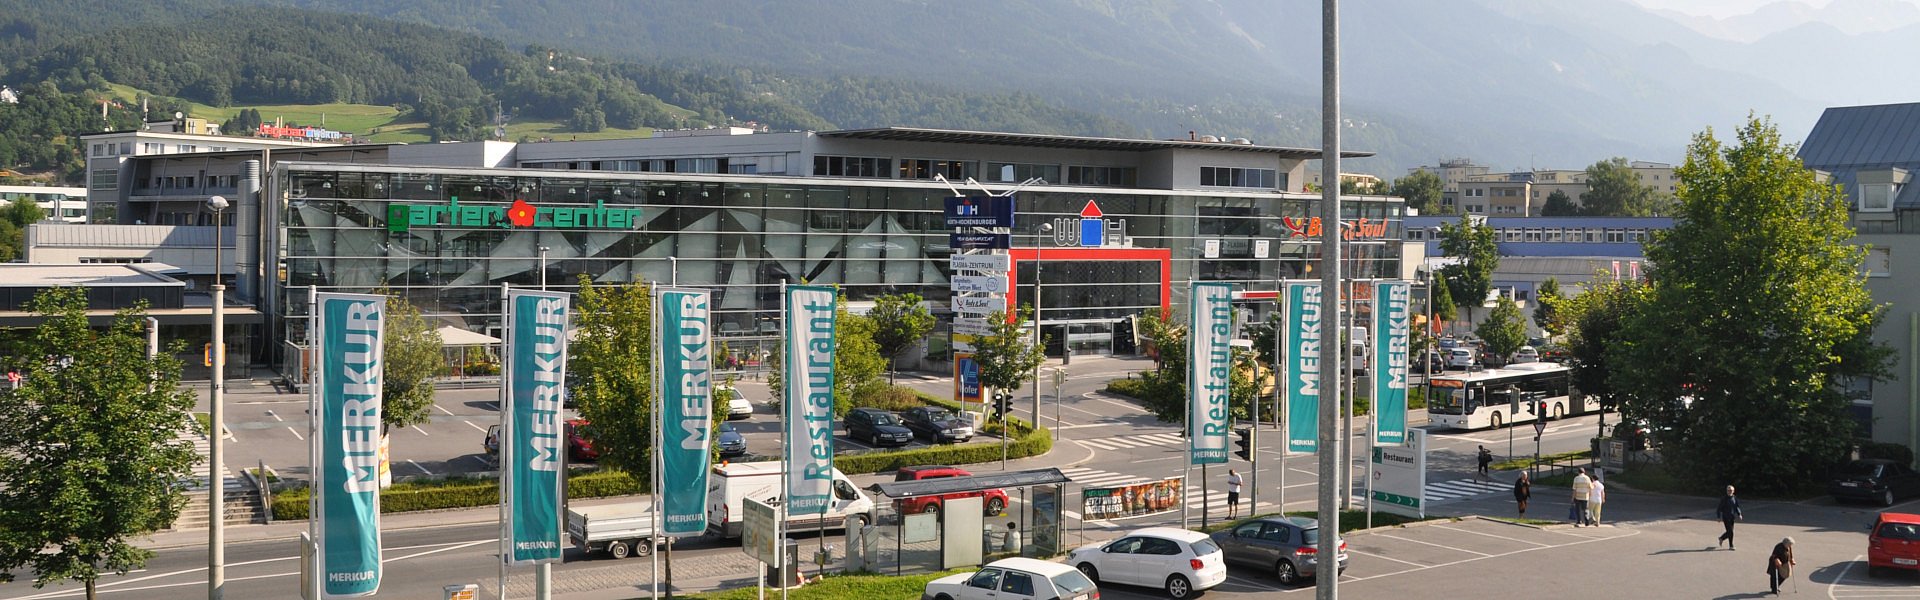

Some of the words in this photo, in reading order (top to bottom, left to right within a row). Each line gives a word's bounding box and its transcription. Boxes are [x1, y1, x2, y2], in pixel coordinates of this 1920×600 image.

[388, 196, 503, 231] garten
[534, 199, 641, 228] center
[1356, 217, 1389, 237] Soul
[1299, 286, 1322, 396] MERKUR
[1388, 285, 1408, 389] MERKUR
[681, 294, 707, 450] MERKUR
[1203, 294, 1229, 437] Restaurant
[342, 301, 379, 493] MERKUR
[530, 298, 565, 472] MERKUR
[804, 300, 833, 481] Restaurant
[1193, 451, 1226, 459] MERKUR
[1291, 439, 1316, 447] MERKUR
[1383, 452, 1414, 464] Restaurant
[667, 513, 703, 523] MERKUR
[516, 541, 556, 550] MERKUR
[329, 570, 375, 582] MERKUR
